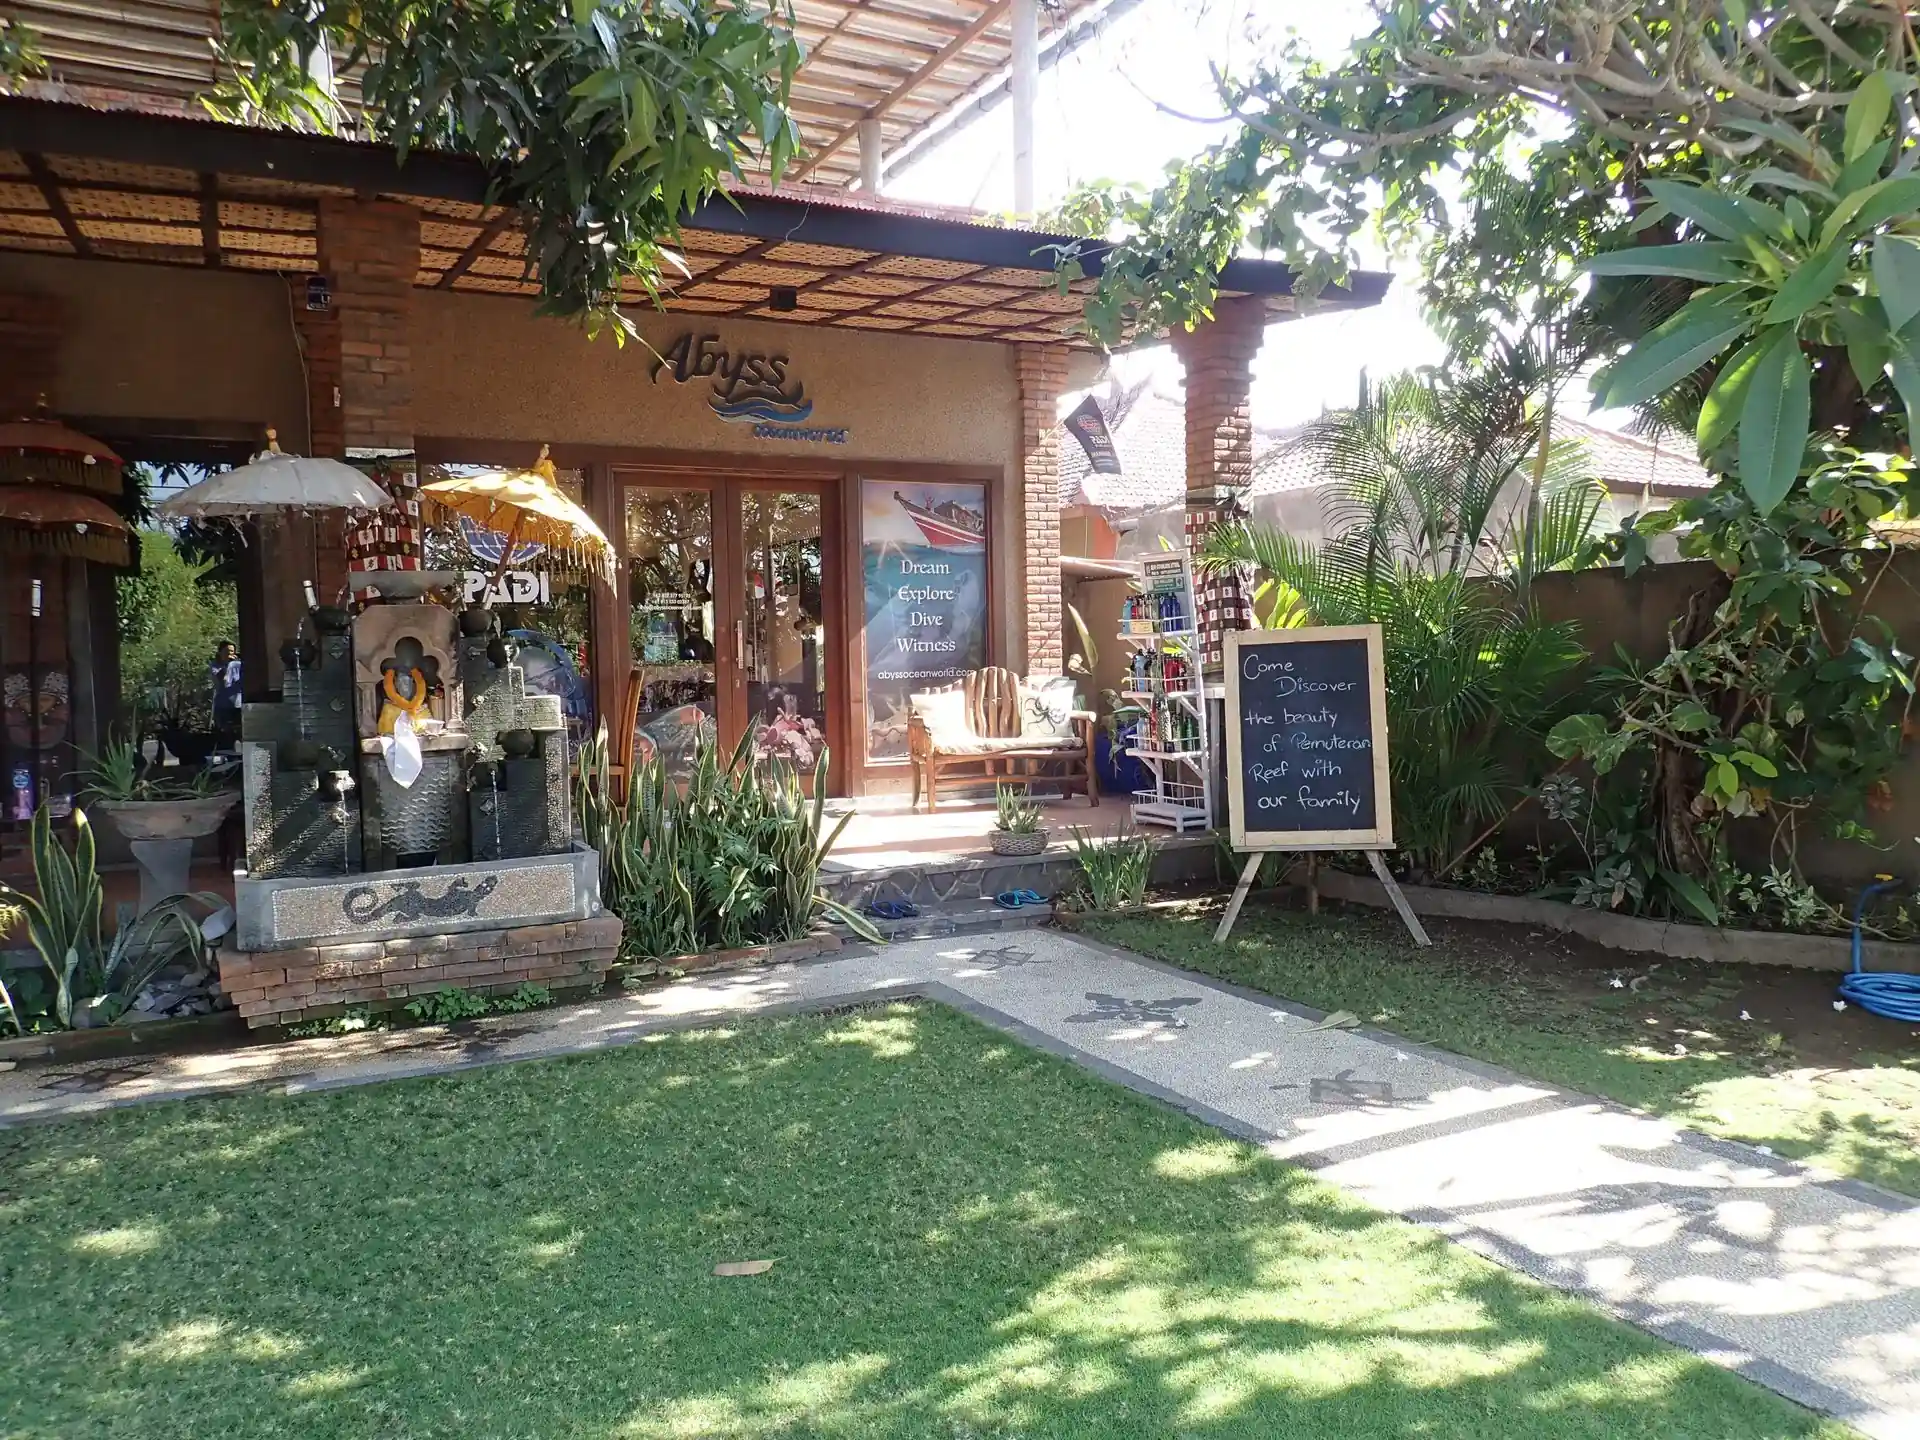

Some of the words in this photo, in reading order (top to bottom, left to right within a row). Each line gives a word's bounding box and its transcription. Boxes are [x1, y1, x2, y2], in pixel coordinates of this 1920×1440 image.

[649, 332, 790, 402] Abyss
[900, 559, 951, 575] Dream
[463, 570, 550, 603] PADI
[898, 585, 954, 605] Explore
[910, 610, 944, 627] Dive
[897, 637, 956, 653] Witness
[1243, 654, 1295, 680] Come
[1274, 676, 1357, 698] Discover
[1244, 708, 1275, 726] the
[1283, 706, 1339, 729] beauty
[1263, 733, 1281, 753] of
[1290, 731, 1372, 751] Pemuteran
[1248, 760, 1289, 784] Reef
[1301, 759, 1342, 779] with
[1257, 794, 1288, 809] our
[1297, 784, 1362, 815] family
